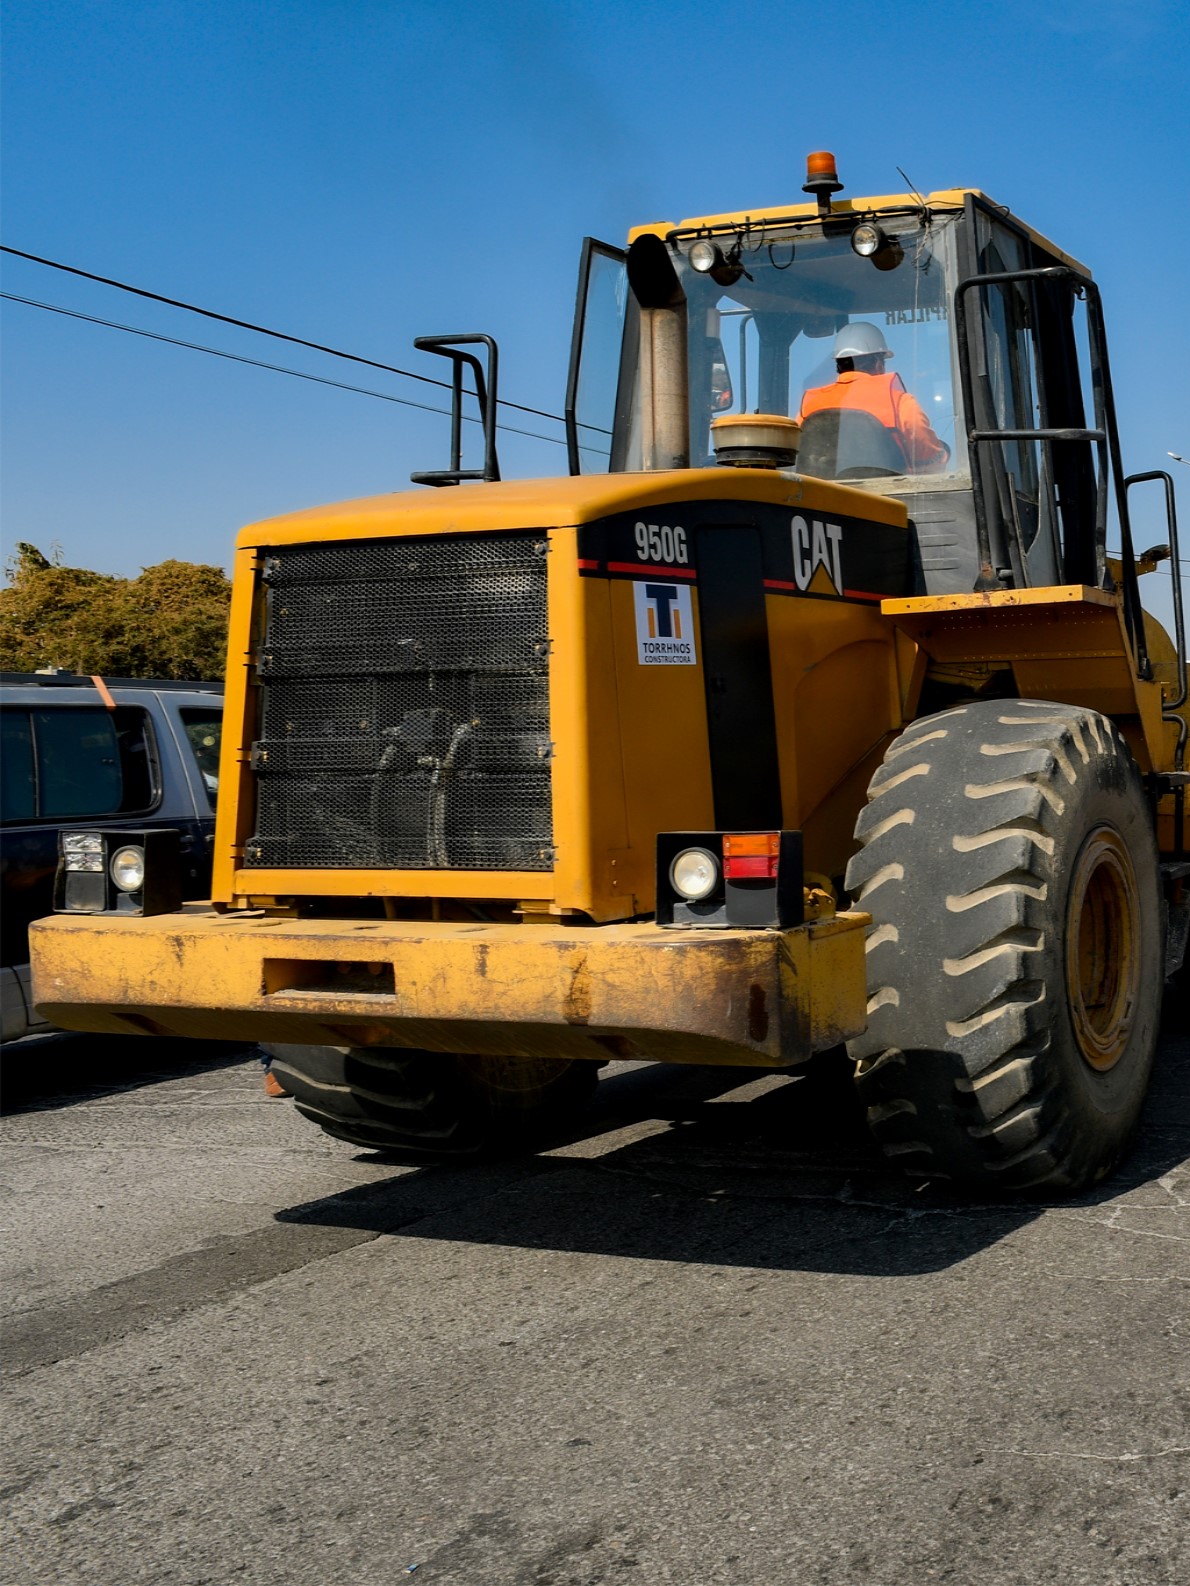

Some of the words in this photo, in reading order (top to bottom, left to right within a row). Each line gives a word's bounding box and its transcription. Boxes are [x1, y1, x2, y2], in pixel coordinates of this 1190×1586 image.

[634, 521, 689, 564] 950G
[790, 515, 844, 597] CAT
[642, 642, 691, 655] TORRHNOS
[644, 655, 691, 664] CONSTRUCTORA
